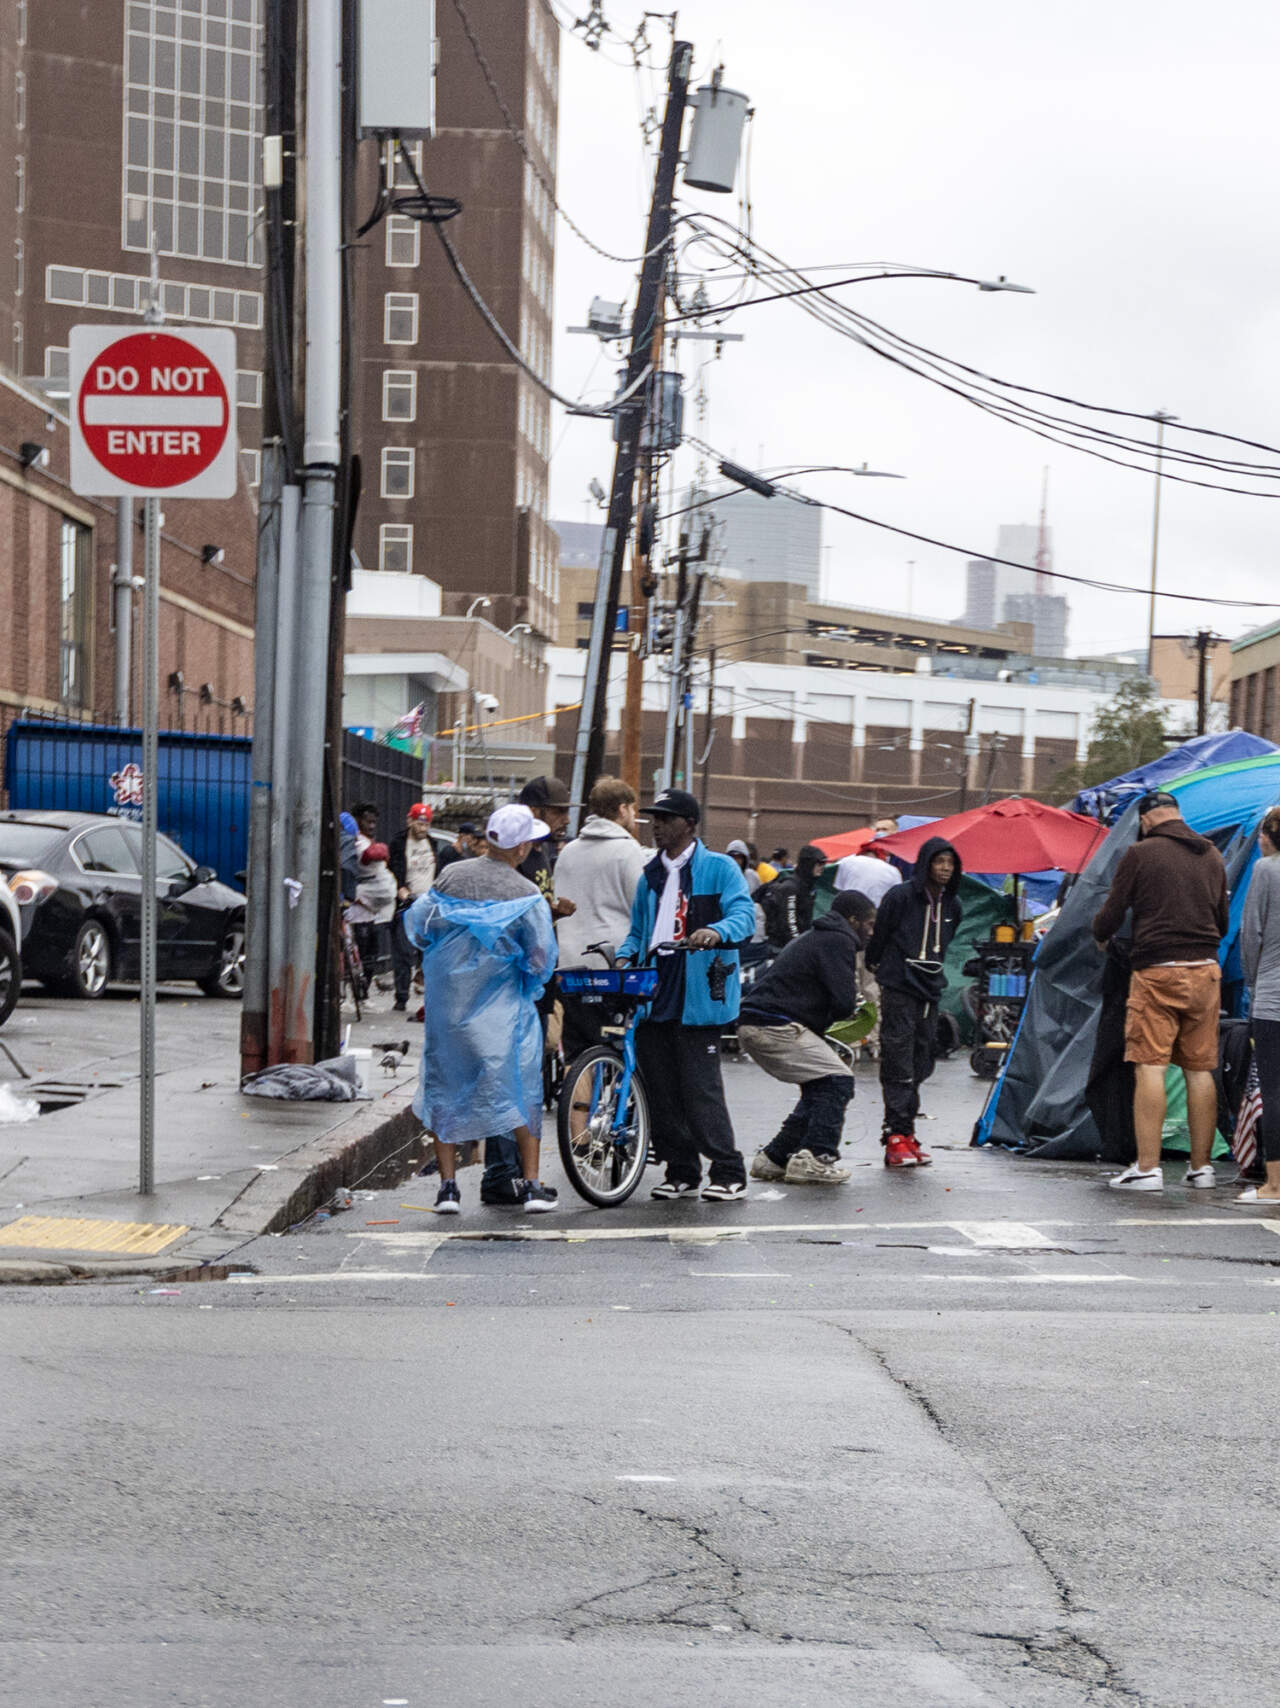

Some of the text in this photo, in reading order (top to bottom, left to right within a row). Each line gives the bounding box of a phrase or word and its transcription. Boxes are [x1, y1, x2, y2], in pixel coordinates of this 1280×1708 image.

[96, 365, 209, 392] DO NOT
[107, 430, 201, 455] ENTER
